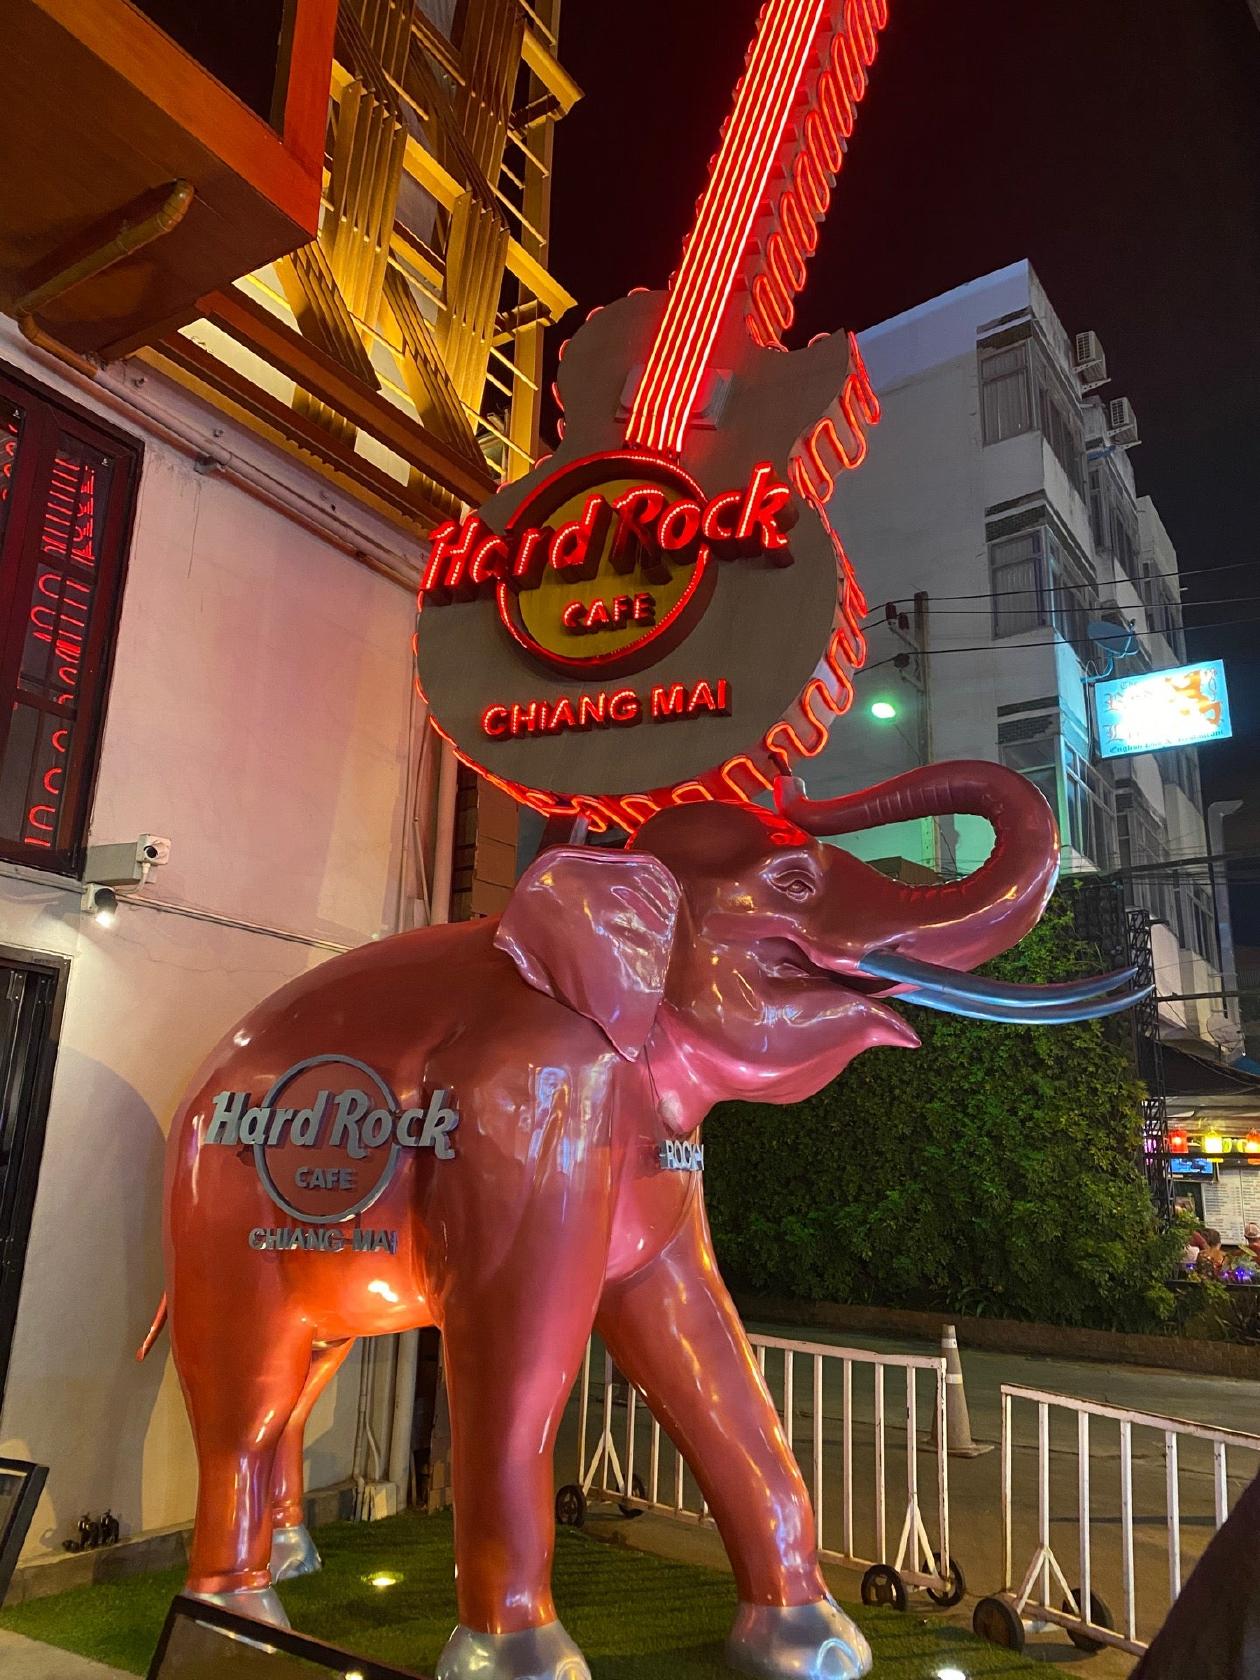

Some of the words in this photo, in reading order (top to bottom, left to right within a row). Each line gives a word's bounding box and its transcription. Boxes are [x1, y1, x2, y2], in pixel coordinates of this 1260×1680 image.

[421, 493, 612, 602] Hard
[611, 460, 794, 580] Rock
[561, 593, 656, 634] CAFE
[481, 690, 640, 738] CHIANG
[651, 679, 731, 720] MAI
[204, 1090, 329, 1146] Hard
[329, 1089, 460, 1159] Rock
[295, 1167, 354, 1189] CAFE
[249, 1227, 344, 1252] CHIANG
[351, 1228, 397, 1254] MAI
